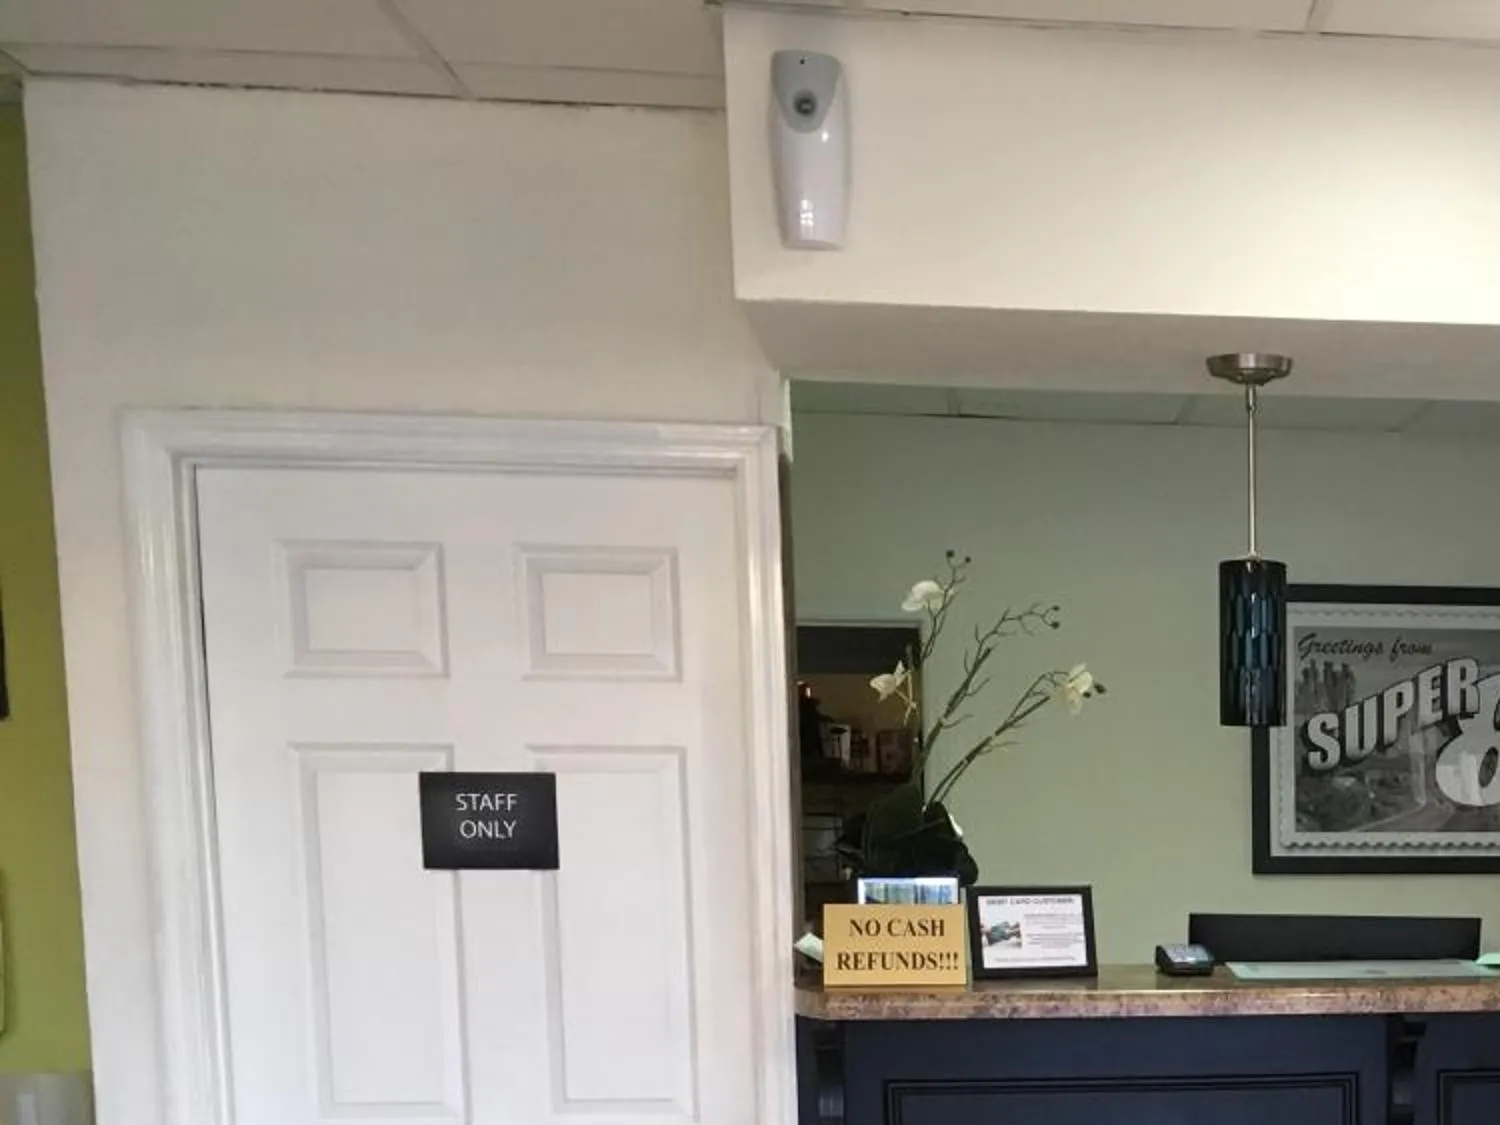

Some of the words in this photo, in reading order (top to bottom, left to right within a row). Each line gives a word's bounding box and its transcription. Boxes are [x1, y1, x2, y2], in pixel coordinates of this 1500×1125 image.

[1298, 633, 1383, 661] Greetings
[1390, 635, 1432, 663] from
[1306, 656, 1481, 771] SUPER
[455, 793, 518, 811] STAFF
[459, 819, 517, 839] ONLY
[849, 918, 881, 937] NO
[887, 918, 945, 937] CASH
[837, 951, 959, 971] REFUNDS!!!
